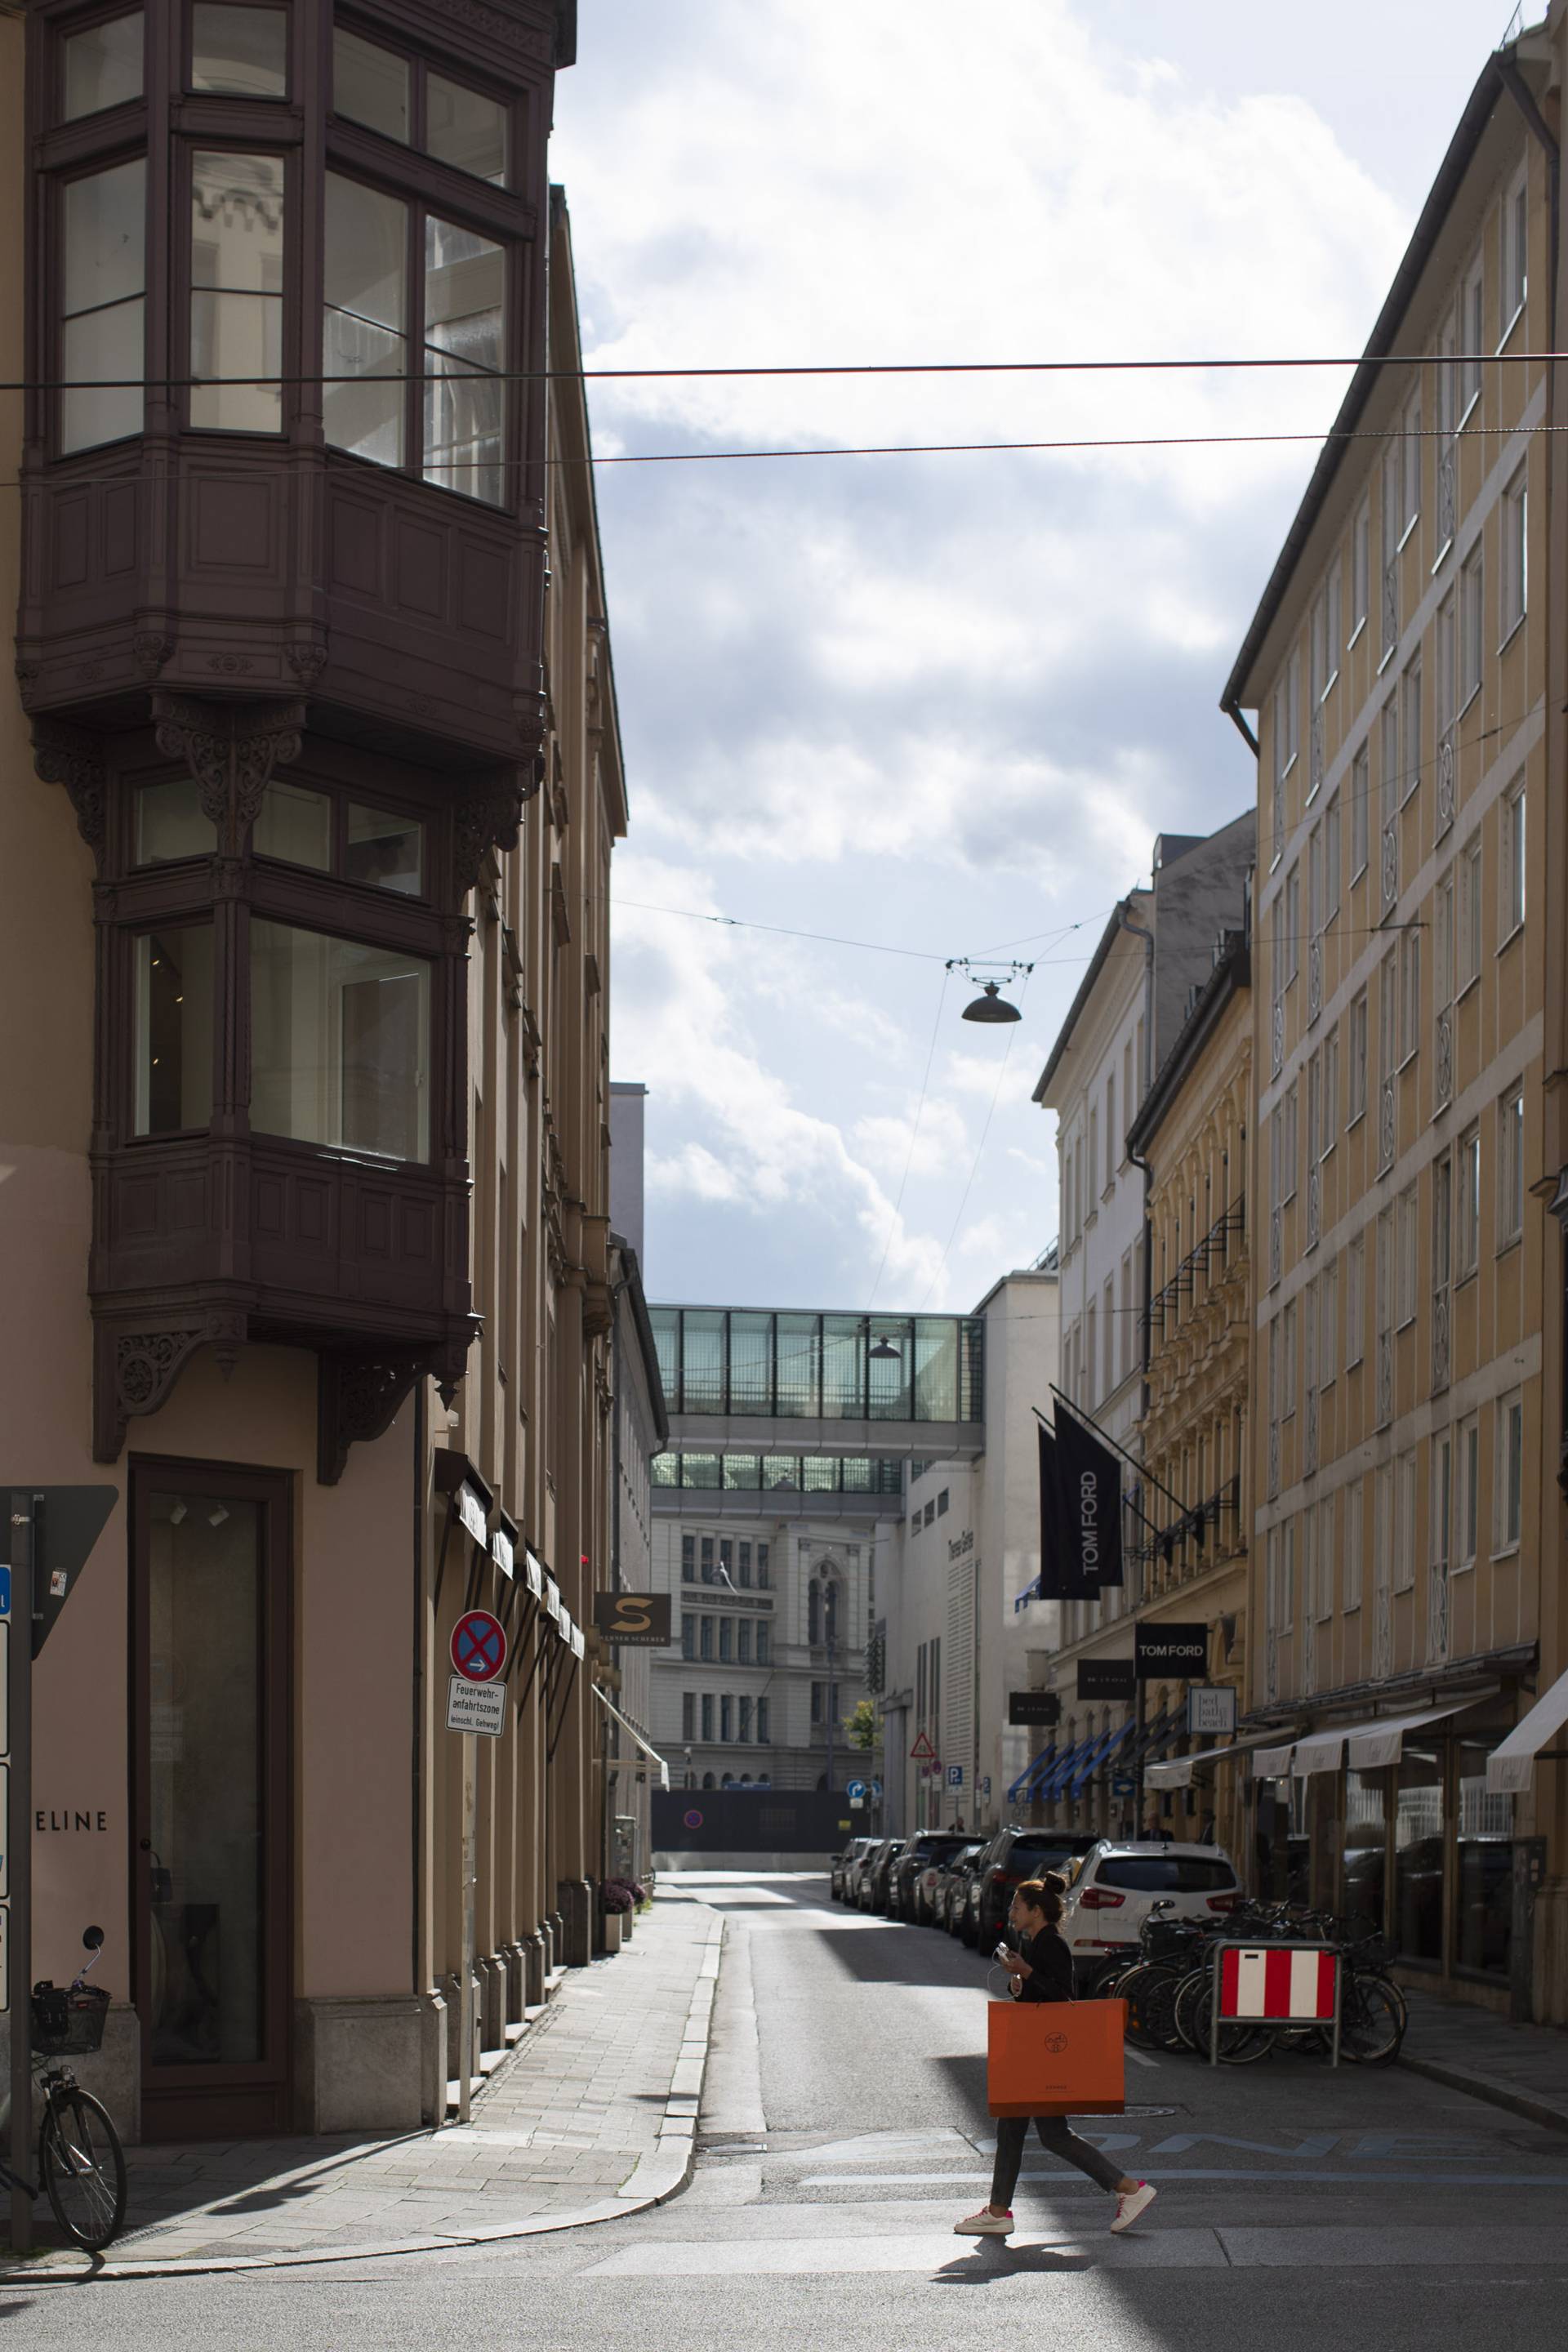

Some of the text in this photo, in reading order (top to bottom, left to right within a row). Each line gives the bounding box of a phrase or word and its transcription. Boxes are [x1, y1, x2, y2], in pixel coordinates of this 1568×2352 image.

[1080, 1471, 1098, 1575] TOM FORD
[609, 1597, 654, 1632] S
[1139, 1645, 1203, 1656] TOM FORD
[456, 1683, 499, 1699] Feuerwehr-
[452, 1699, 500, 1715] anfahrtszone
[36, 1811, 107, 1831] ELINE
